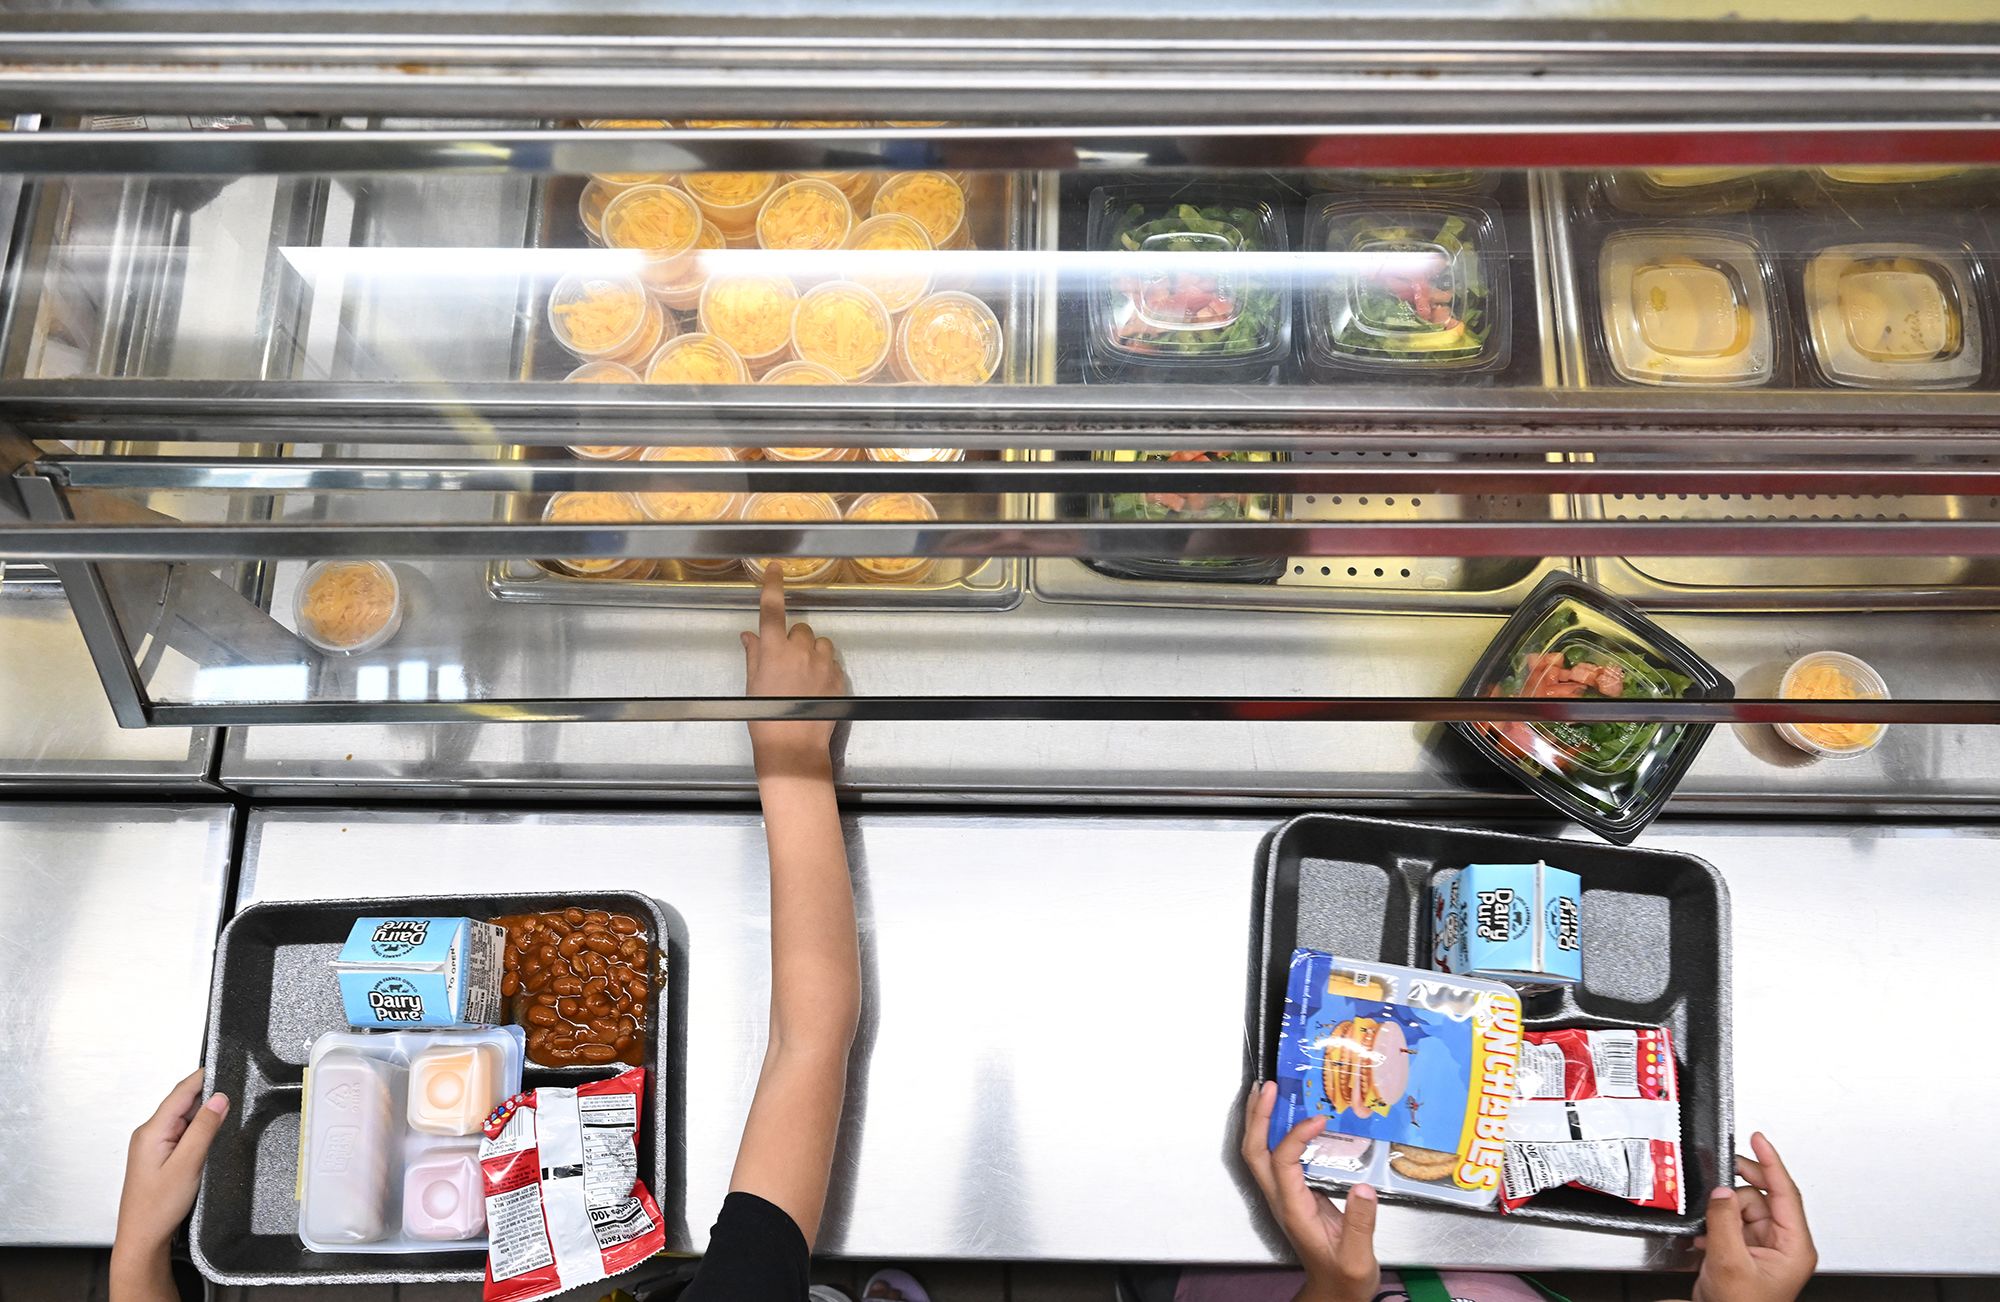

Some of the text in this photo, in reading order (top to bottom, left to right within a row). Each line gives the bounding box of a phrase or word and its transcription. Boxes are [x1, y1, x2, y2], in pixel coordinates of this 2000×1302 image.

[1477, 891, 1495, 942] Pure
[1491, 888, 1514, 943] Dairy
[379, 920, 430, 931] Pure
[1557, 896, 1571, 952] Dairy
[1569, 903, 1580, 951] Pure
[371, 931, 427, 945] Dairy
[448, 975, 455, 989] TO
[369, 992, 422, 1011] Dairy
[376, 1007, 424, 1021] Pure
[1459, 1001, 1519, 1187] LUNCHABLES
[1503, 1163, 1516, 1196] Nutrition
[518, 1189, 538, 1201] CONTAINS
[527, 1184, 537, 1192] AND
[611, 1197, 638, 1214] Calories
[590, 1210, 610, 1221] 100
[599, 1234, 621, 1245] Facts
